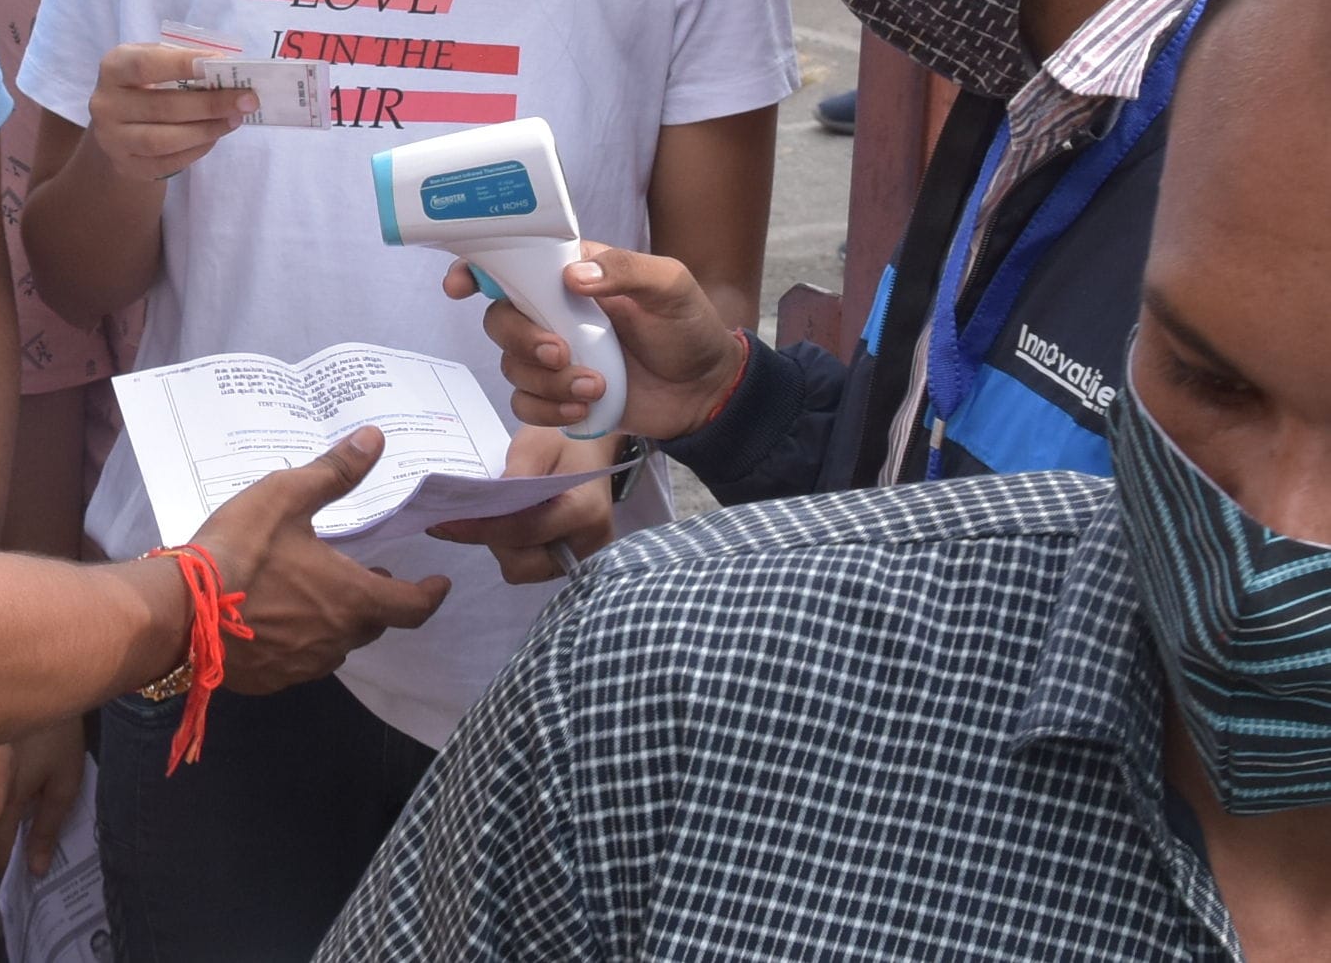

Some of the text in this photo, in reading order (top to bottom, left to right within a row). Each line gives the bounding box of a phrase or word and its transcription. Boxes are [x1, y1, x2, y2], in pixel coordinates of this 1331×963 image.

[270, 30, 456, 70] IS IN THE
